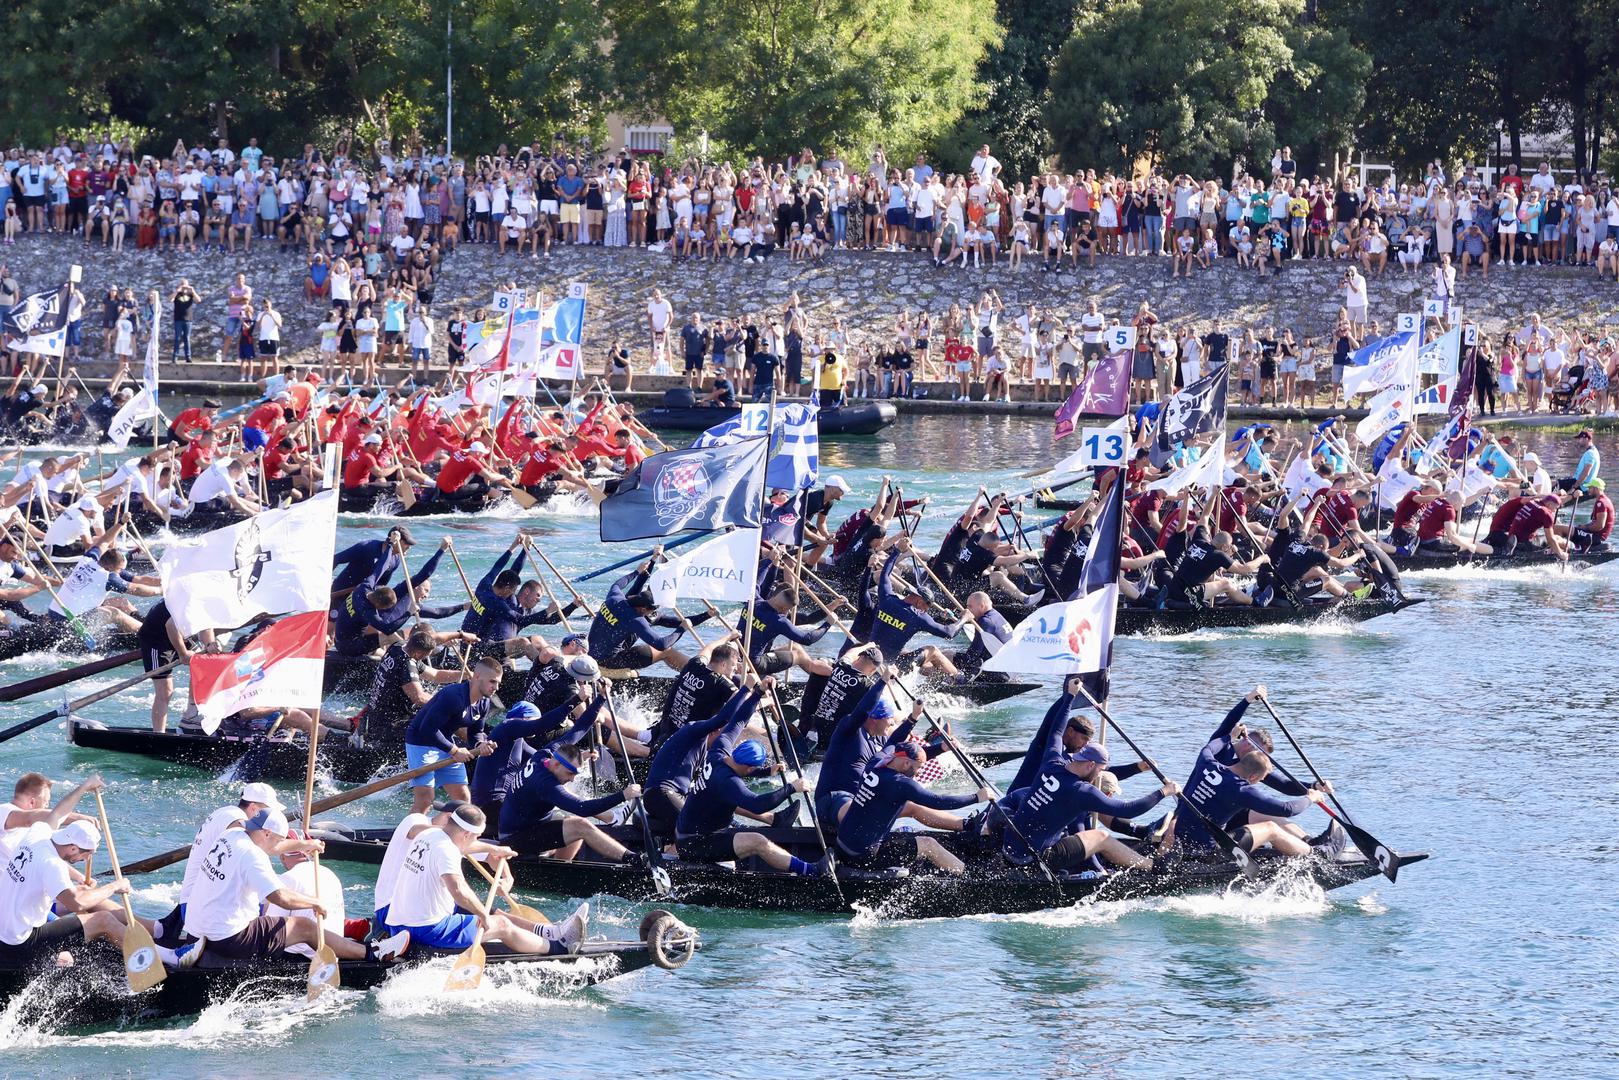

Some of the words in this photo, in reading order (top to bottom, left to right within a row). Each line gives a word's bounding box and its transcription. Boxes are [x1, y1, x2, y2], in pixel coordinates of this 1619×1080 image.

[574, 286, 582, 296] 9
[498, 297, 508, 308] 8
[1428, 303, 1437, 313] 4
[1404, 316, 1414, 329] 3
[1451, 311, 1456, 321] 1
[1116, 331, 1127, 345] 5
[1468, 328, 1475, 342] 2
[1232, 345, 1237, 359] 6
[743, 410, 768, 431] 12
[1085, 434, 1123, 461] 13
[741, 608, 766, 632] HM
[878, 610, 906, 631] HRM
[682, 671, 705, 690] ARGO
[831, 666, 858, 687] ARGO
